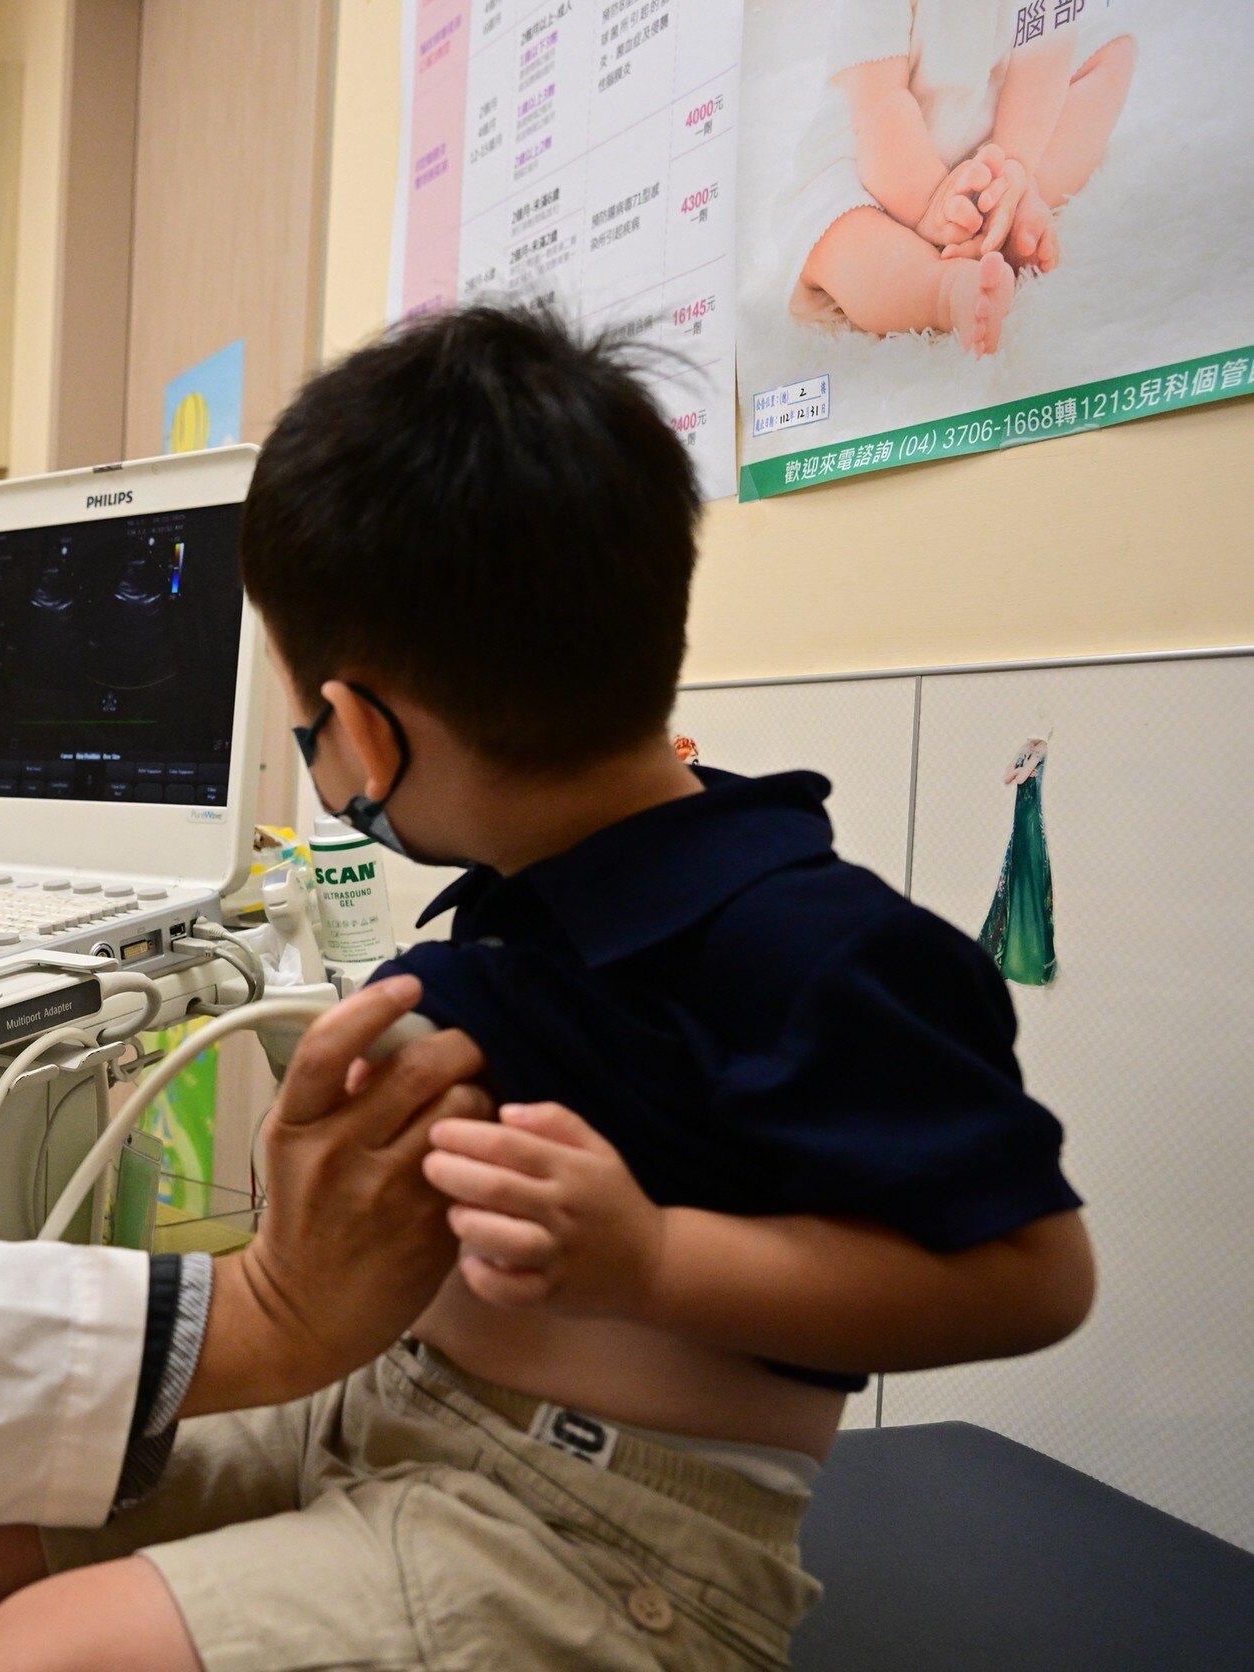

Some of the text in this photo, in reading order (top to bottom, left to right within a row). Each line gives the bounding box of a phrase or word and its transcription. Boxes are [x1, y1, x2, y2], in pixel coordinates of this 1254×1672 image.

[686, 94, 723, 127] 4000元
[681, 183, 718, 213] 4300元
[672, 295, 715, 326] 16145元
[784, 441, 894, 484] 歡迎來電諮詢
[898, 429, 937, 460] (04)
[86, 491, 133, 508] PHILIPS
[315, 861, 375, 885] SCAN
[323, 887, 372, 900] ULTRASOUND
[340, 900, 354, 908] GEL
[6, 1001, 73, 1031] Multiport Adapter
